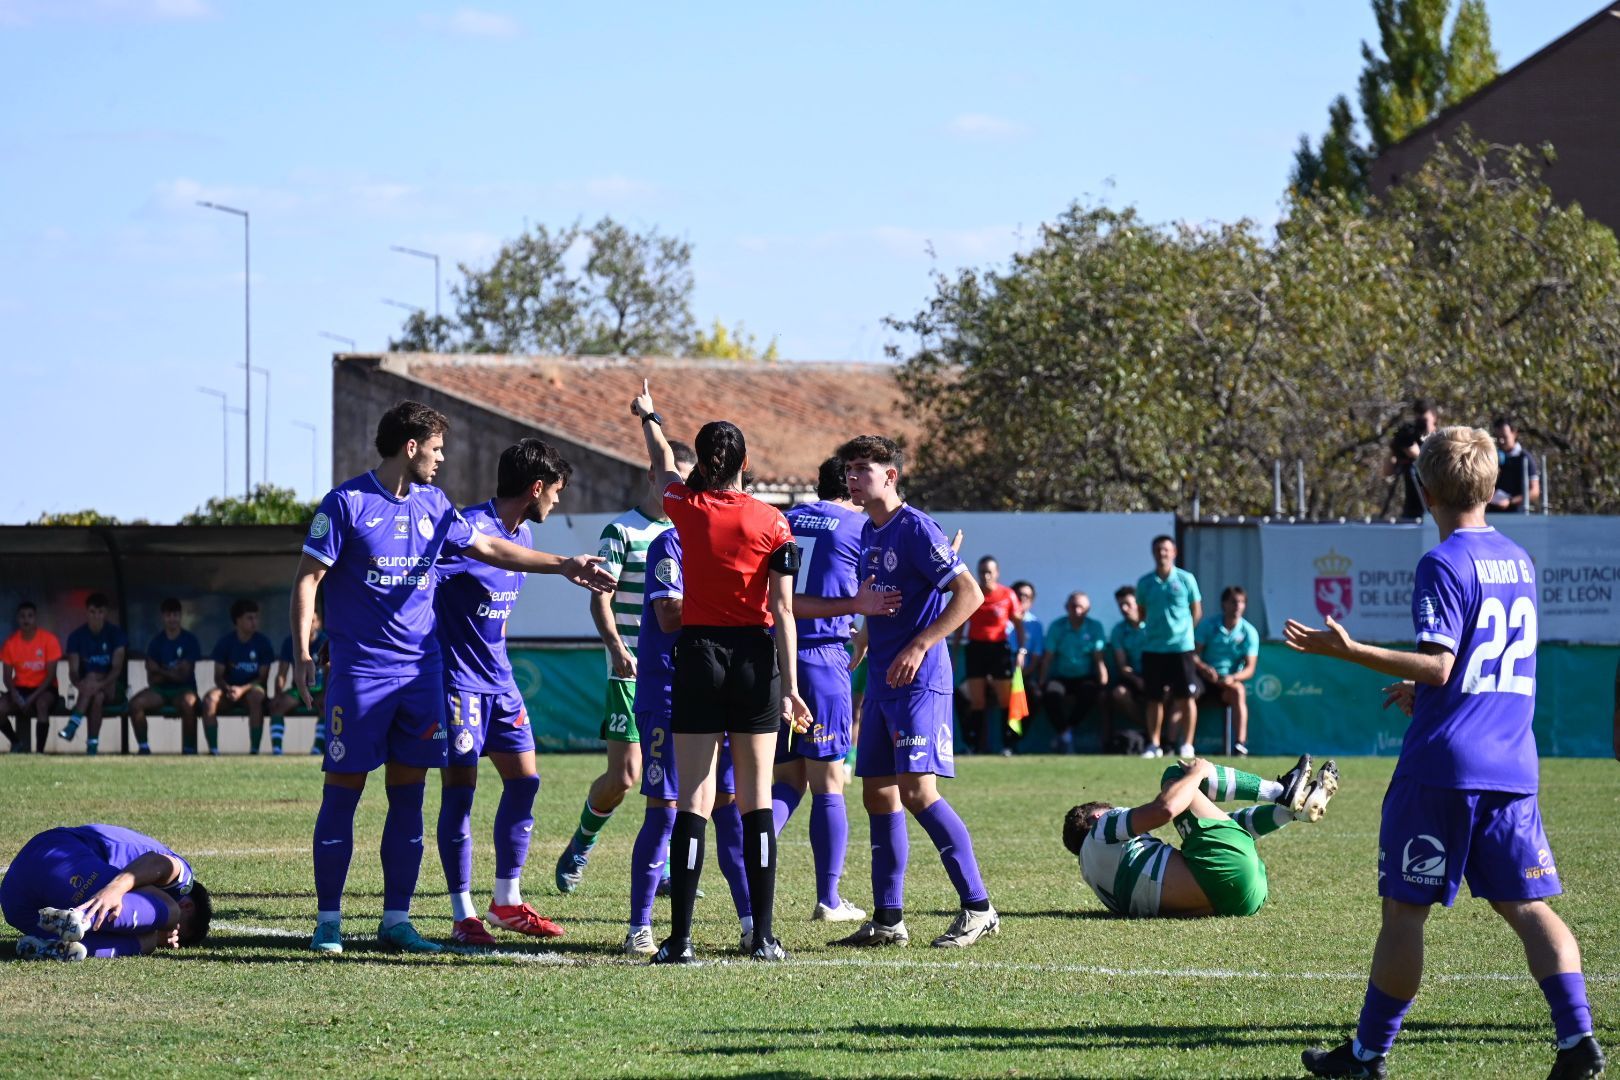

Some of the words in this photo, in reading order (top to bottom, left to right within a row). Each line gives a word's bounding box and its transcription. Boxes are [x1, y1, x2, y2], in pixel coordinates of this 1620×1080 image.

[793, 514, 840, 531] PEREDO
[377, 554, 431, 567] euronics
[1474, 559, 1519, 584] ALVARO
[1518, 559, 1533, 584] G.
[1359, 590, 1380, 606] DE
[1543, 587, 1563, 604] DE
[1568, 582, 1612, 603] LEÓN
[1462, 596, 1537, 696] 22
[331, 705, 343, 735] 6
[450, 695, 481, 727] 15
[609, 713, 628, 733] 22
[650, 727, 665, 758] 2
[896, 735, 928, 748] antolin
[1402, 874, 1424, 885] TACO
[1424, 877, 1444, 886] BELL
